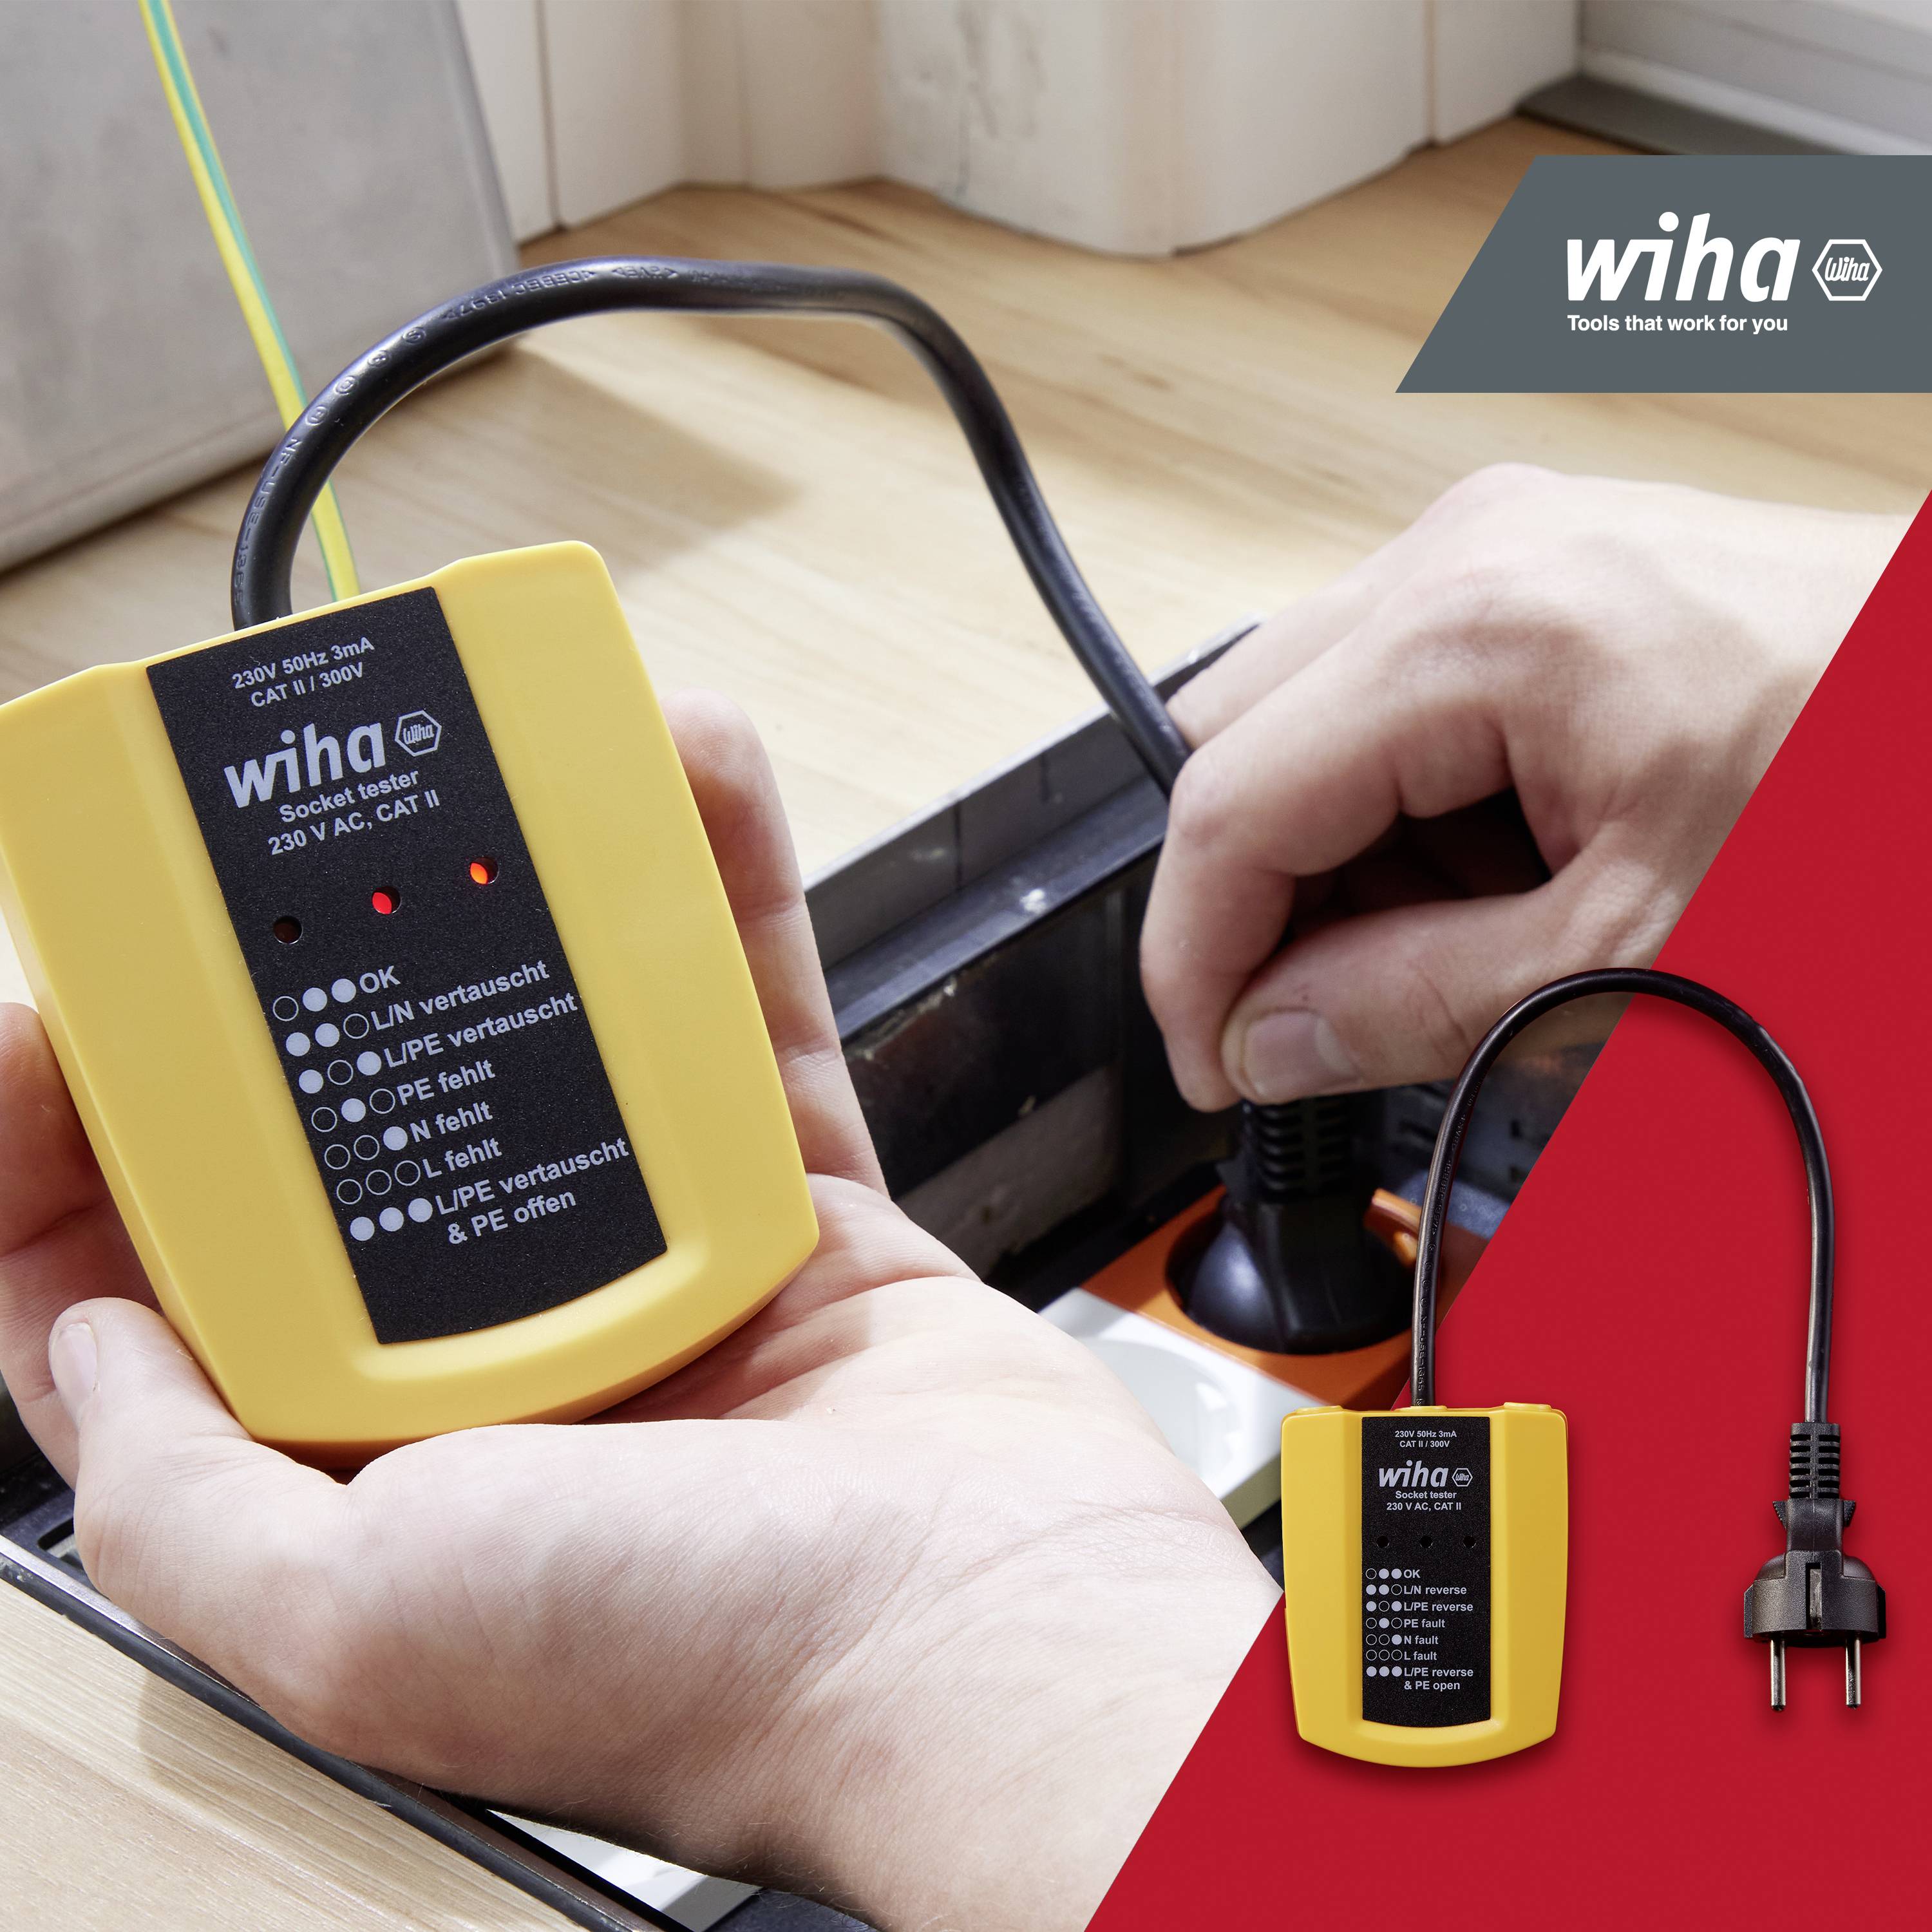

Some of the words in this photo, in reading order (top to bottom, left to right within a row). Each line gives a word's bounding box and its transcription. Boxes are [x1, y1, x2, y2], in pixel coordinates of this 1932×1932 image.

[232, 663, 275, 688] 230V
[283, 652, 328, 674] 50Hz
[331, 638, 374, 659] 3mA
[252, 684, 287, 706] CAT
[293, 680, 305, 695] II
[310, 676, 314, 691] /
[319, 662, 362, 687] 300V
[224, 723, 386, 809] wiha
[279, 788, 355, 822] Socket
[358, 771, 419, 799] tester
[269, 830, 307, 855] 230
[310, 822, 325, 840] V
[335, 813, 372, 836] AC,
[377, 795, 418, 821] CAT
[424, 790, 440, 808] II
[360, 966, 401, 993] OK
[371, 1001, 414, 1030] L/N
[419, 961, 549, 1014] vertauscht
[384, 1033, 444, 1067] L/PE
[447, 993, 578, 1046] vertauscht
[397, 1078, 434, 1105] PE
[438, 1060, 495, 1092] fehlt
[410, 1120, 431, 1142] N
[435, 1101, 493, 1134] fehlt
[422, 1159, 442, 1178] L
[445, 1138, 502, 1171] fehlt
[436, 1180, 495, 1214] L/PE
[498, 1138, 629, 1193] vertauscht
[448, 1224, 468, 1244] &
[471, 1209, 508, 1236] PE
[514, 1192, 576, 1222] offen
[1379, 1460, 1448, 1487] wiha
[1414, 1502, 1431, 1511] AC,
[1404, 1569, 1420, 1578] OK
[1404, 1586, 1421, 1594] L/N
[1405, 1602, 1428, 1611] L/PE
[1405, 1619, 1418, 1627] PE
[1421, 1619, 1445, 1627] fault
[1405, 1636, 1411, 1644] N
[1415, 1636, 1438, 1644] fault
[1414, 1651, 1437, 1660] fault
[1404, 1681, 1412, 1689] &
[1416, 1681, 1430, 1689] PE
[1433, 1683, 1460, 1692] open
[1405, 1667, 1428, 1676] L/PE
